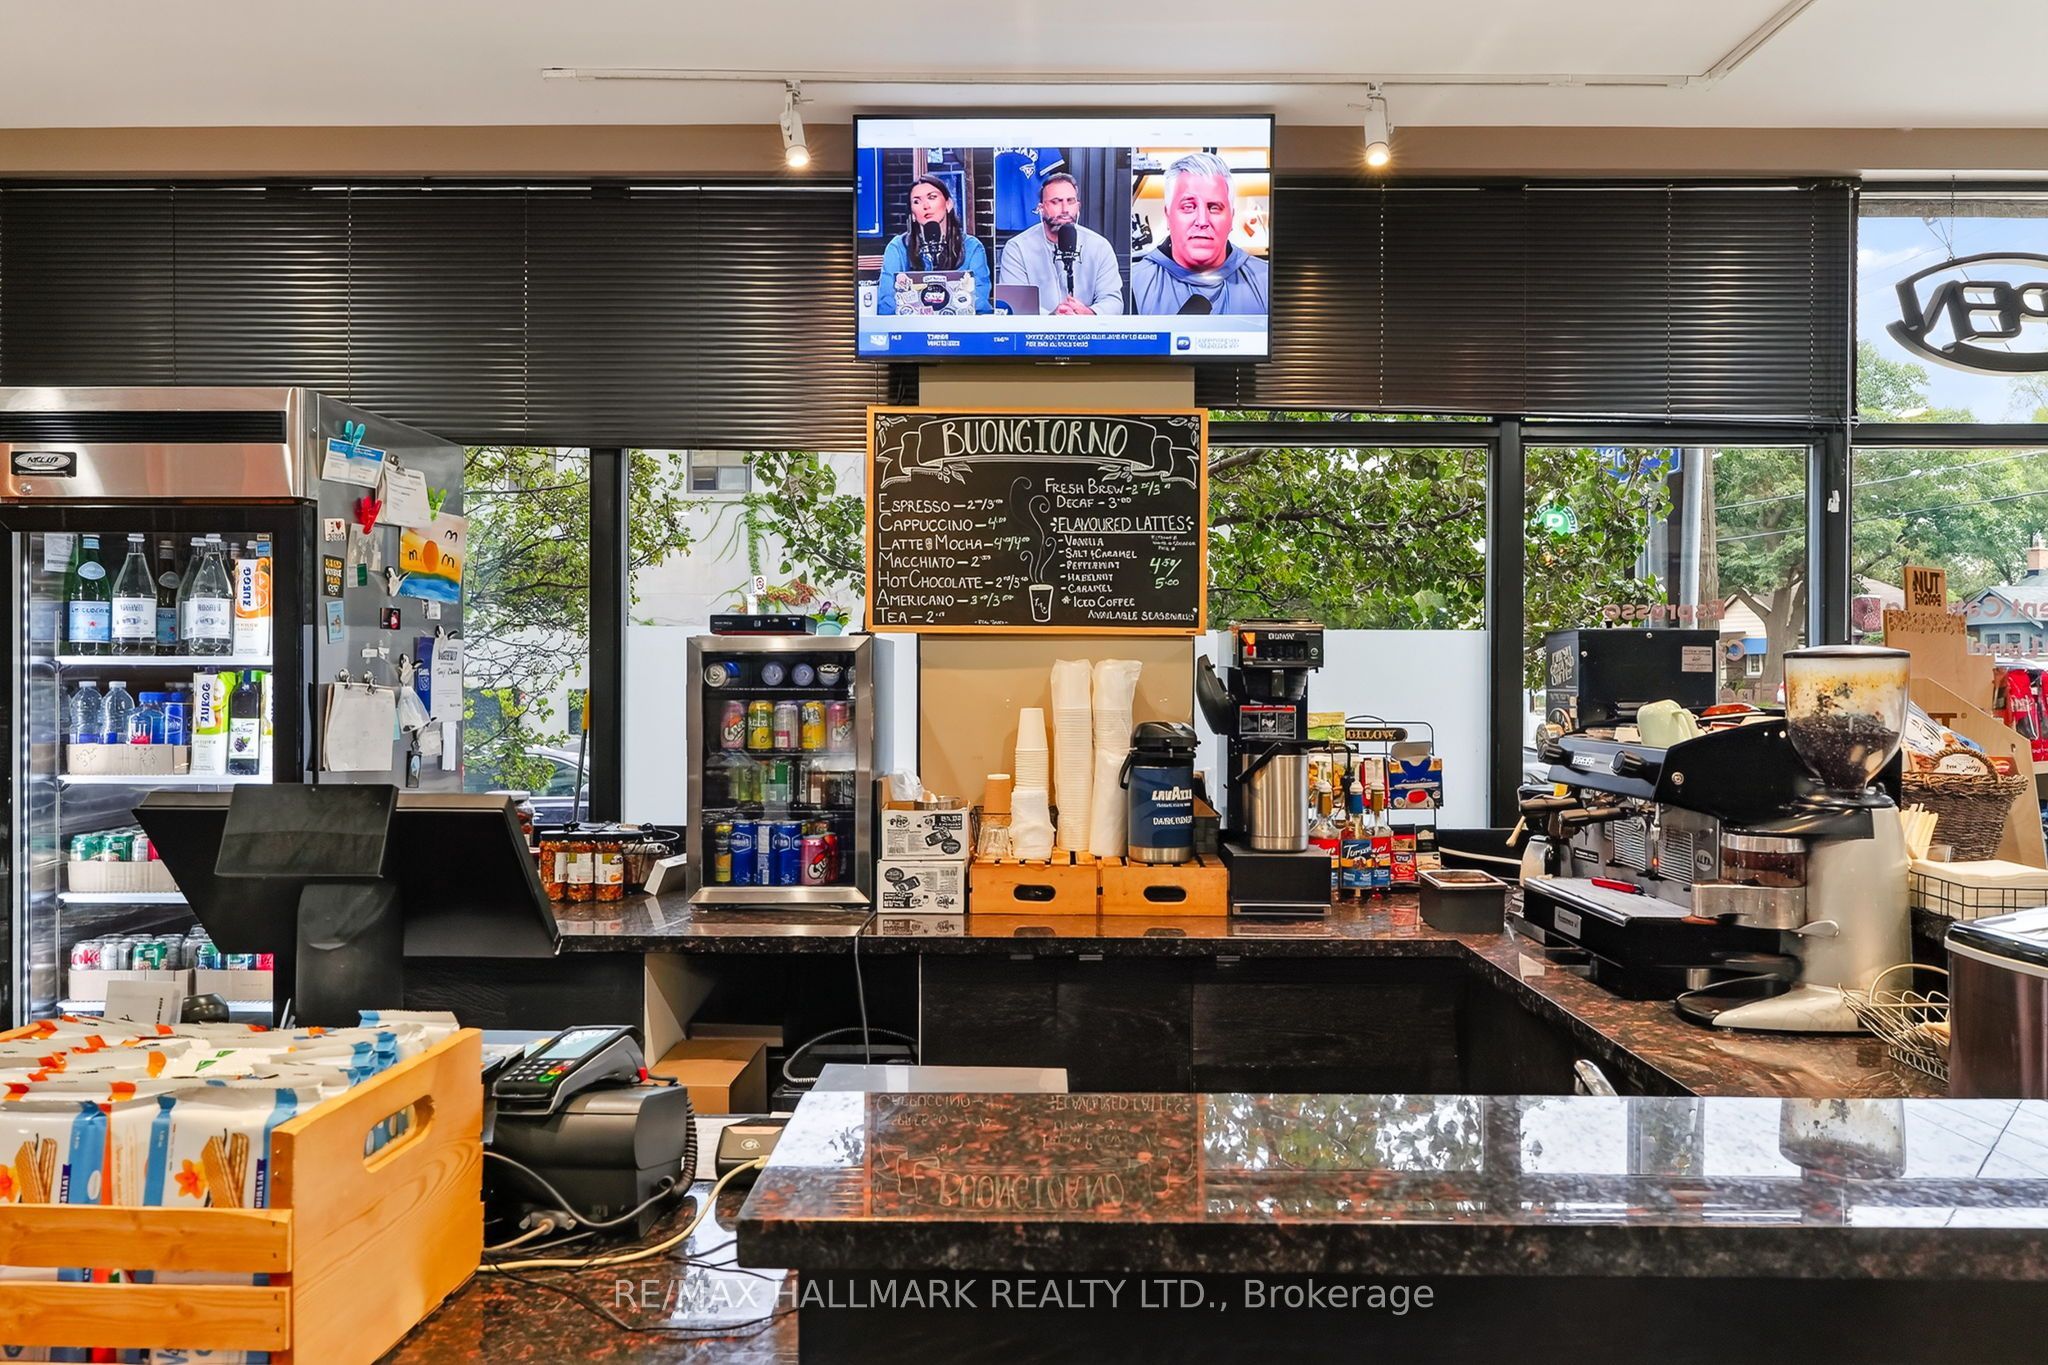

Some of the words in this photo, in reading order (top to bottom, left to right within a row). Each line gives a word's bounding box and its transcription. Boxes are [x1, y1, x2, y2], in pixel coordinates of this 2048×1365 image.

[942, 419, 1128, 457] BUONGIORNO
[1045, 477, 1085, 494] FRESH
[878, 493, 950, 513] ESPRESSO
[1056, 495, 1094, 509] DECAF
[878, 513, 974, 532] CAPPUCCINO
[1058, 516, 1132, 532] FLAVOURED
[1135, 515, 1186, 532] LATTES
[935, 534, 983, 551] MOCHA
[878, 551, 955, 569] MACCHIATO
[909, 569, 983, 589] CHOCOLATE
[1913, 570, 1940, 593] NUT
[876, 589, 955, 607] AMERICANO
[876, 607, 908, 623] TEA
